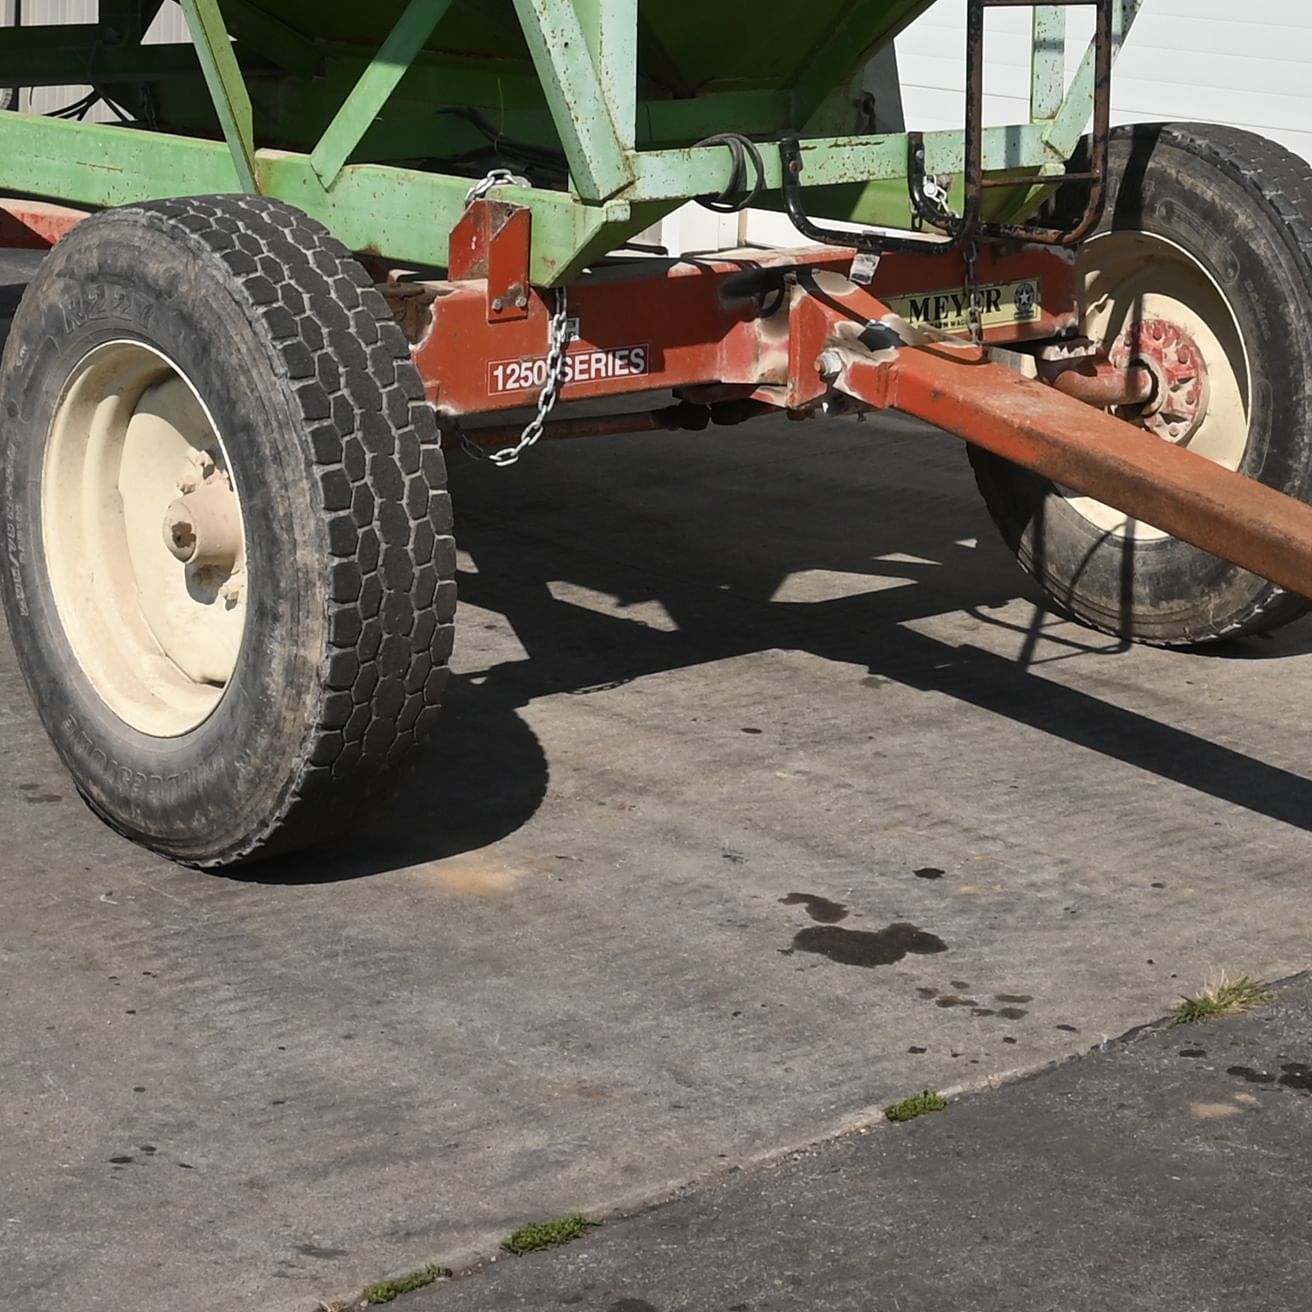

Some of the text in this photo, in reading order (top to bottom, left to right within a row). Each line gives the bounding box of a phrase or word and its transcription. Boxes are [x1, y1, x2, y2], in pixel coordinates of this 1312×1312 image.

[909, 288, 1002, 324] MEYER
[493, 347, 645, 391] 1250 SERIES
